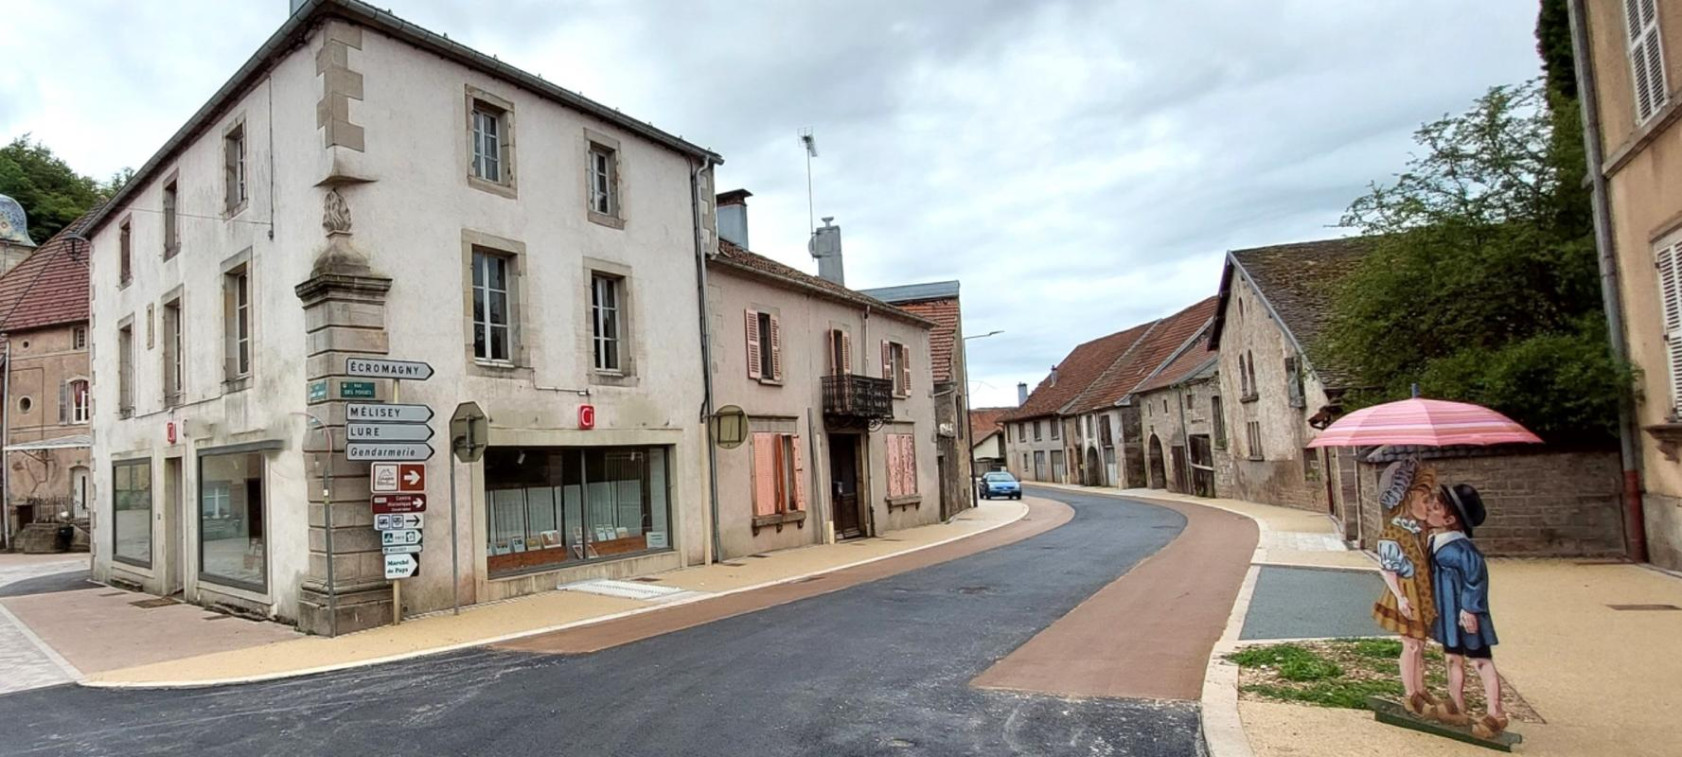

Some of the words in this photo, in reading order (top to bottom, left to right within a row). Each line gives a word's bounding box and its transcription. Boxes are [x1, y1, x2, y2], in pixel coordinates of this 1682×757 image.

[350, 361, 420, 375] ÉCROMAGNY
[350, 406, 401, 418] MÉLISEY
[350, 427, 380, 437] LURE
[350, 447, 416, 457] Gendarmerie
[387, 559, 409, 567] Marché
